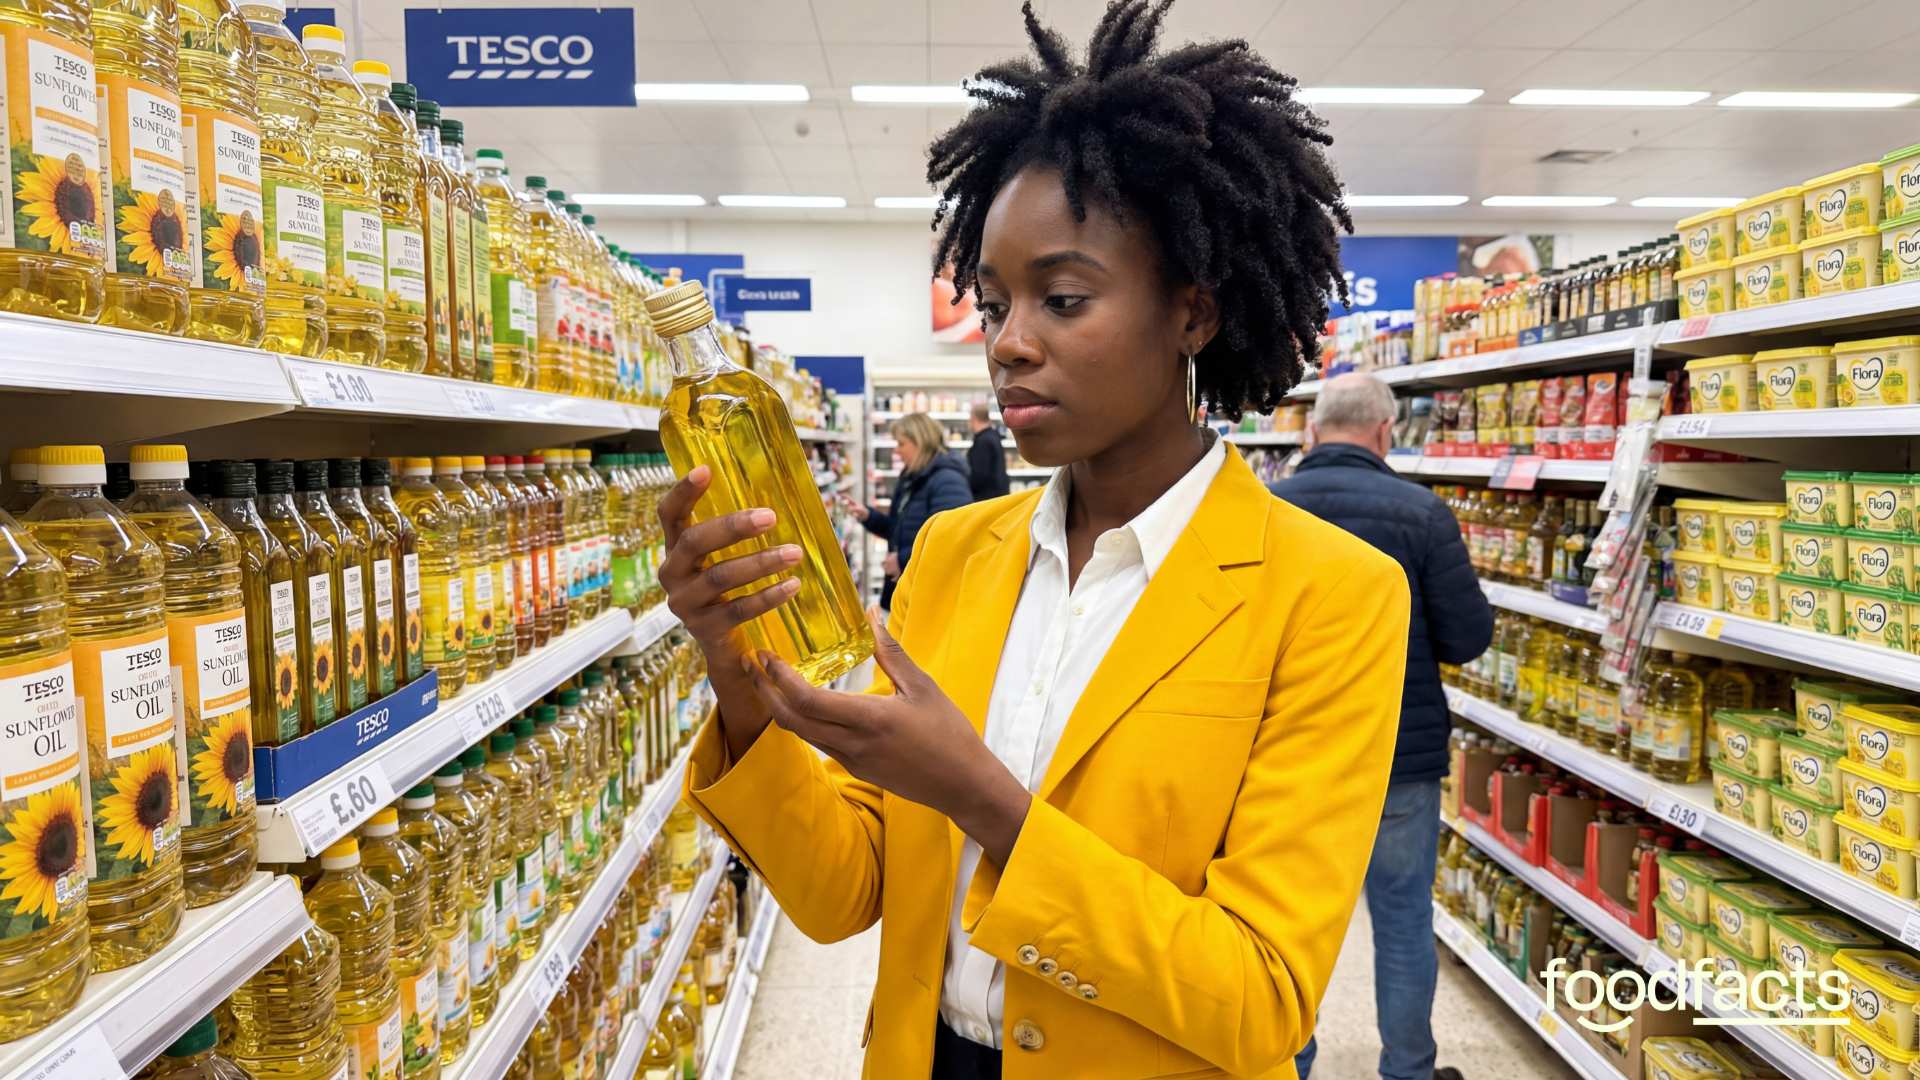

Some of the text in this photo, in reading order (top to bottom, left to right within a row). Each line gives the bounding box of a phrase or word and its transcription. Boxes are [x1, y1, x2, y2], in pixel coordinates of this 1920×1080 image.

[447, 35, 594, 65] TESCO
[54, 55, 87, 76] TESCO
[62, 94, 83, 113] OIL
[149, 101, 177, 119] TESCO
[156, 136, 173, 153] OIL
[231, 130, 256, 147] TESCO
[237, 162, 253, 177] OIL
[1900, 172, 1920, 189] Flor
[1818, 198, 1843, 214] Flora
[1748, 219, 1769, 233] Flora
[1689, 234, 1707, 249] Flora
[1816, 258, 1842, 273] Flora
[1747, 272, 1768, 287] Flora
[1687, 285, 1706, 300] Flora
[1770, 375, 1792, 387] Flora
[1852, 366, 1879, 380] Flora
[1798, 493, 1820, 506] Flora
[1868, 496, 1893, 511] Flora
[1795, 544, 1817, 559] Flora
[1861, 553, 1886, 568] Flora
[1791, 595, 1813, 611] Flora
[1858, 607, 1883, 623] Flora
[215, 624, 242, 640] TESCO
[126, 647, 162, 666] TESCO
[222, 666, 244, 687] OIL
[22, 675, 64, 697] TESCO
[136, 696, 164, 720] OIL
[356, 708, 389, 737] TESCO
[34, 729, 67, 757] OIL
[1861, 734, 1885, 752] Flora
[1793, 759, 1816, 778] Flora
[330, 775, 377, 827] £.60
[1856, 791, 1884, 811] Flora
[1783, 811, 1804, 830] Flora
[1853, 843, 1878, 864] Flora
[1851, 989, 1875, 1015] Flora
[1848, 1042, 1871, 1069] Flora
